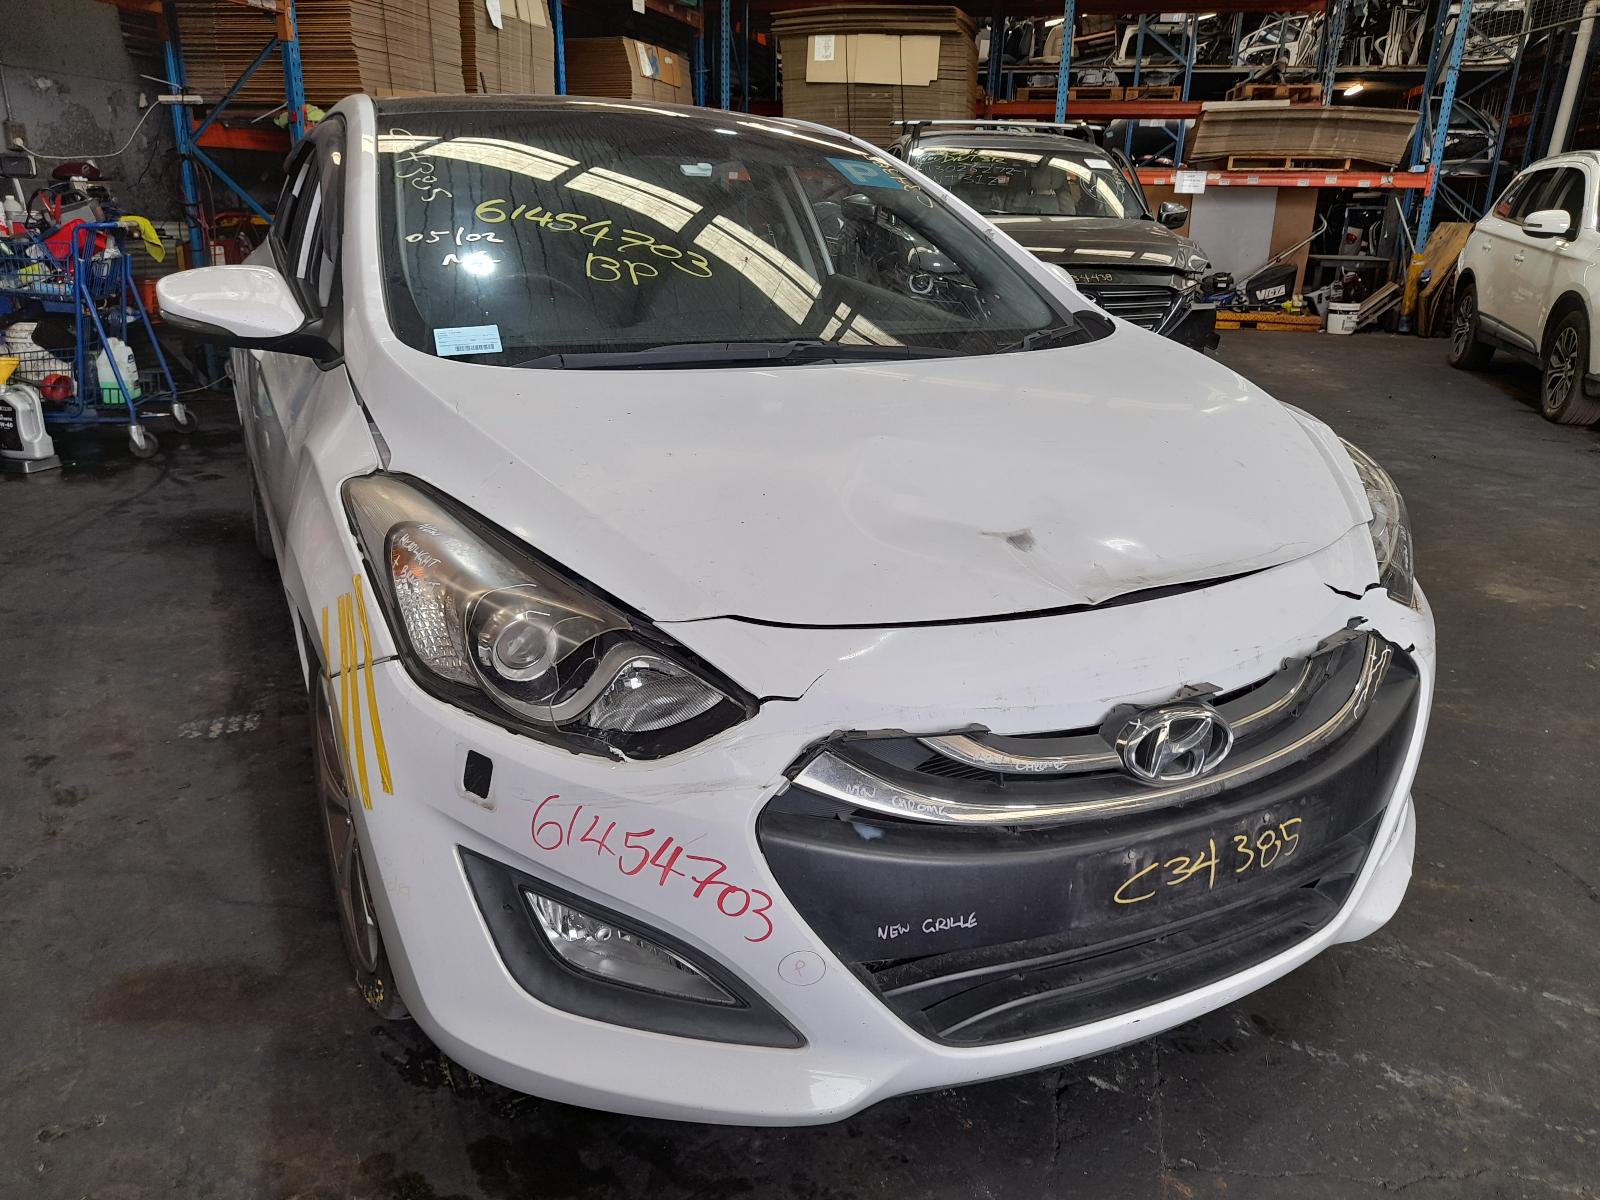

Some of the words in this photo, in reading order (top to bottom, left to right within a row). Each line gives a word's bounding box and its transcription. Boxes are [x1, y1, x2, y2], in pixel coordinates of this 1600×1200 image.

[404, 226, 505, 246] 05/02
[474, 198, 713, 278] 61454703
[585, 252, 659, 286] BP
[400, 532, 441, 568] HEADLIGHT
[531, 794, 773, 943] 61454703
[877, 922, 910, 940] NEW
[922, 911, 978, 933] GRILLE
